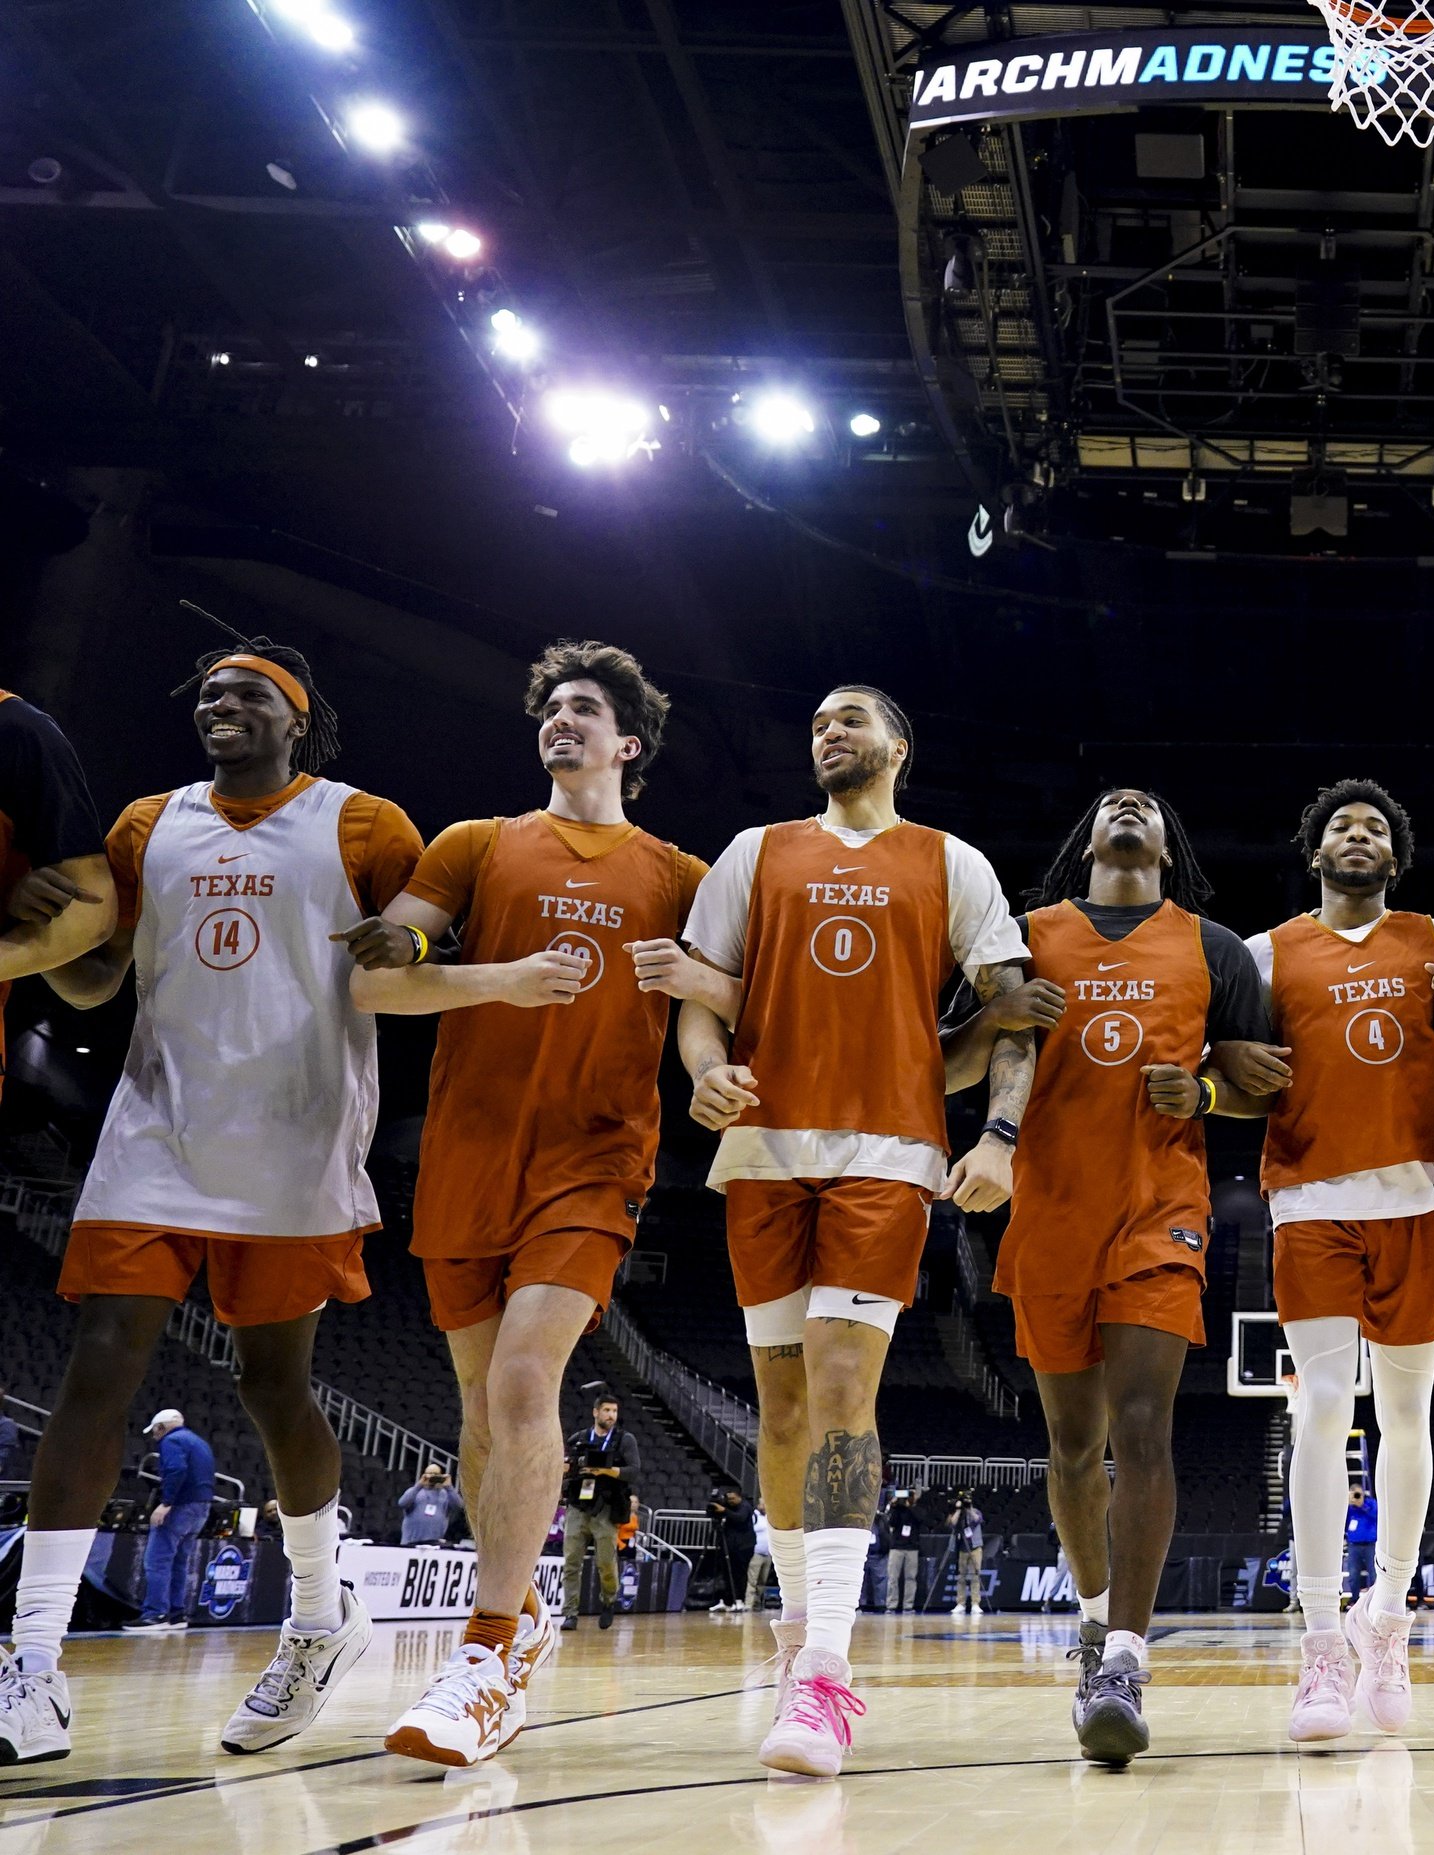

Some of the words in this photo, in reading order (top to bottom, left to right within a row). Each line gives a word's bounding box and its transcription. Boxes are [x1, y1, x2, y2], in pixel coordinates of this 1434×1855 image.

[190, 874, 275, 897] TEXAS
[806, 883, 890, 906] TEXAS
[538, 894, 624, 929] TEXAS
[213, 919, 240, 956] 14
[834, 927, 853, 962] 0
[1074, 980, 1155, 1001] TEXAS
[1328, 977, 1406, 1005] TEXAS
[1103, 1020, 1121, 1052] 5
[1368, 1019, 1385, 1050] 4
[400, 1558, 438, 1609] BIG
[440, 1560, 464, 1608] 12
